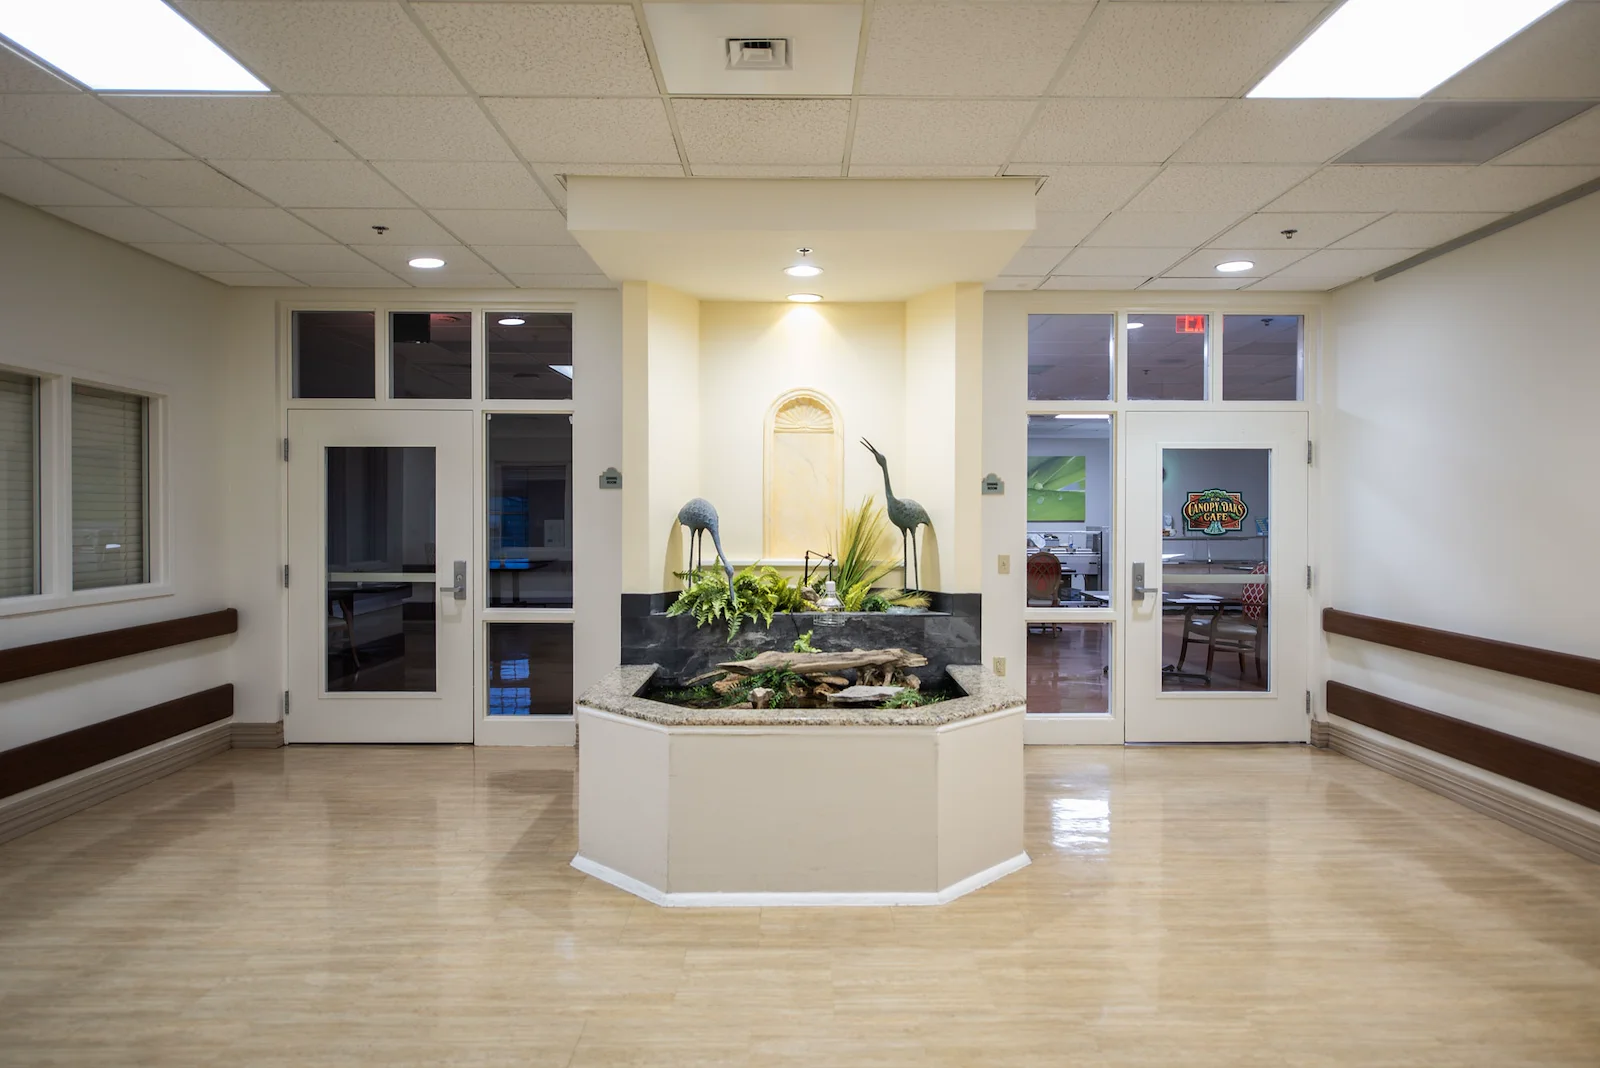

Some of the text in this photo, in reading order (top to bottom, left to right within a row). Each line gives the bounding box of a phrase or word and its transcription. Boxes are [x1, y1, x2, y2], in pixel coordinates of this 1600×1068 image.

[1188, 501, 1243, 516] CANOPY OAKS
[1204, 513, 1227, 521] CAFE
